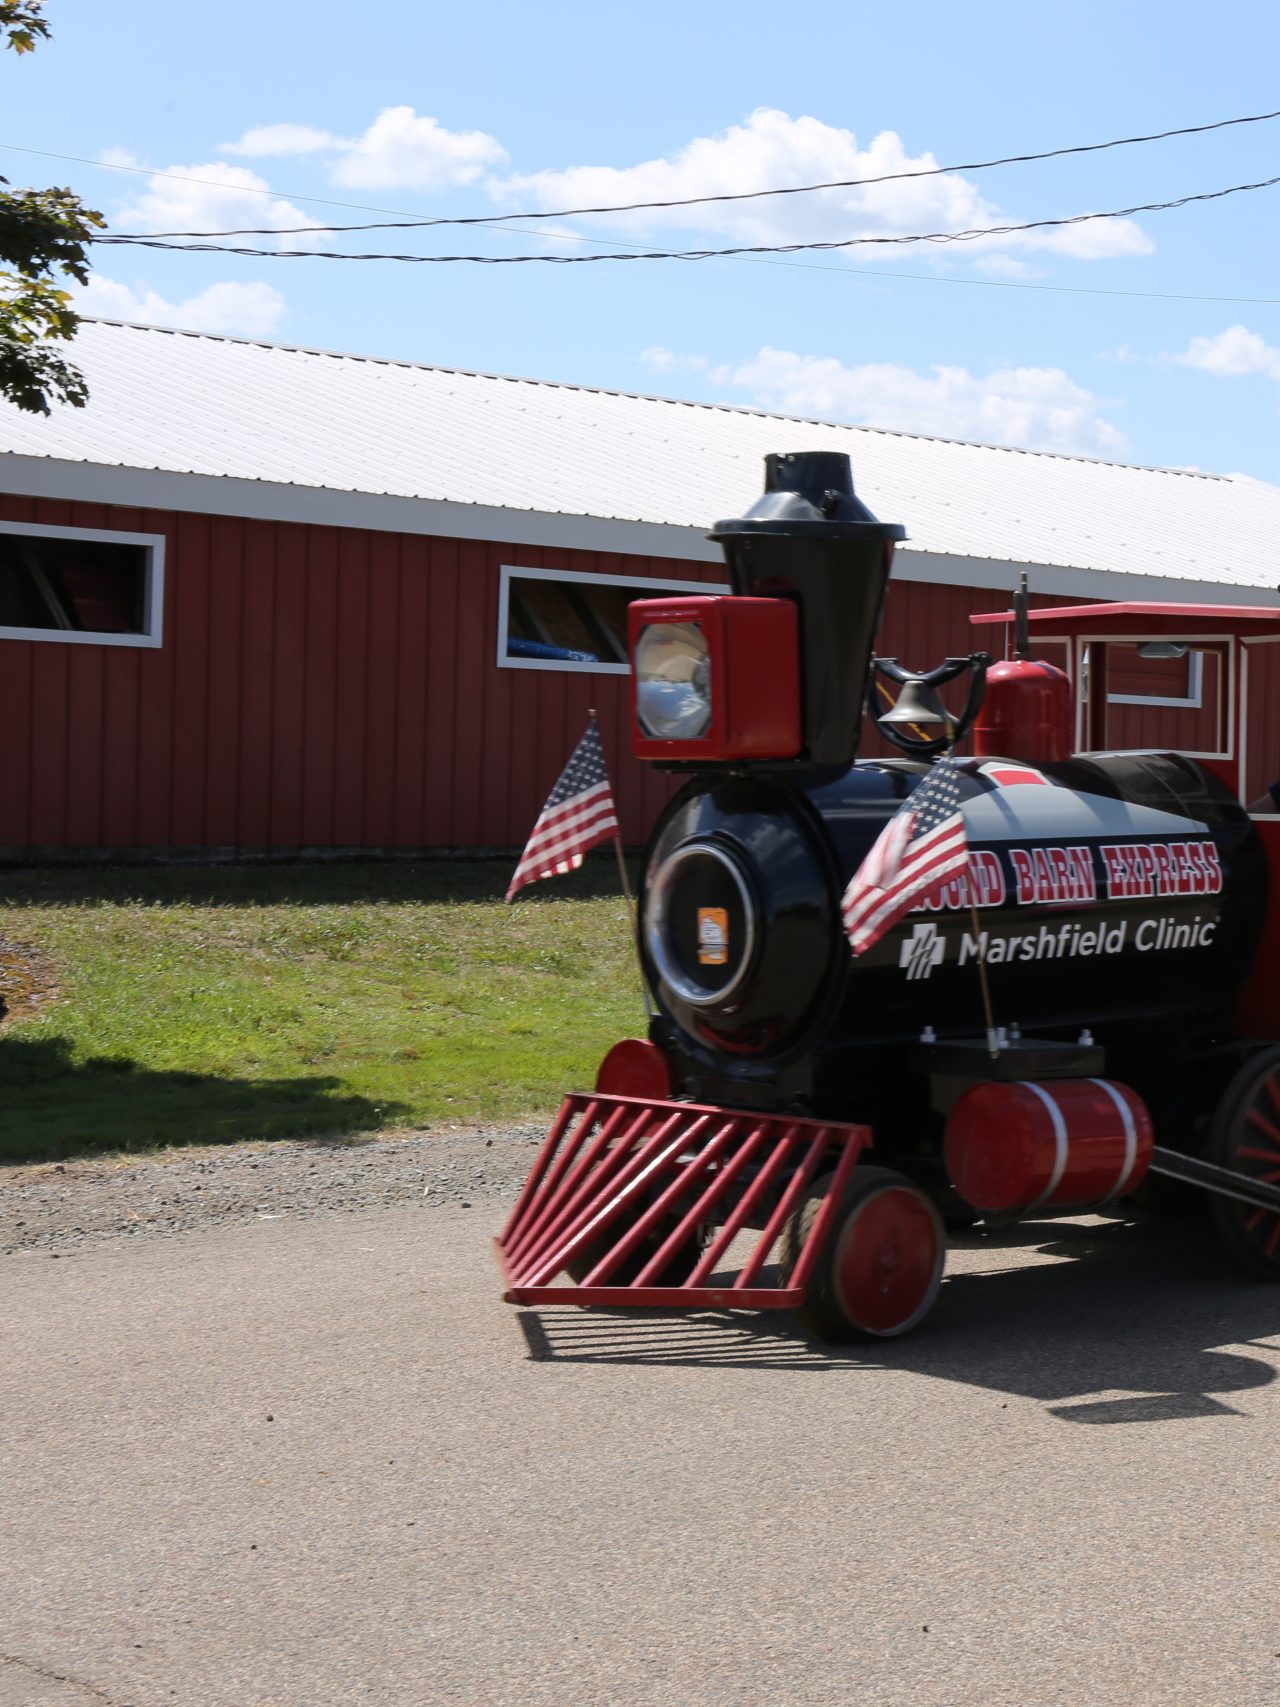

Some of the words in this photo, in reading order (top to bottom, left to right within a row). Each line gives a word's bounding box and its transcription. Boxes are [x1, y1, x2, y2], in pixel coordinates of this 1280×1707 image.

[908, 850, 1006, 912] UND
[1008, 846, 1097, 905] BARN
[1099, 841, 1223, 900] EXPRESS
[958, 920, 1128, 967] Marshfield
[1134, 915, 1217, 952] Clinic
